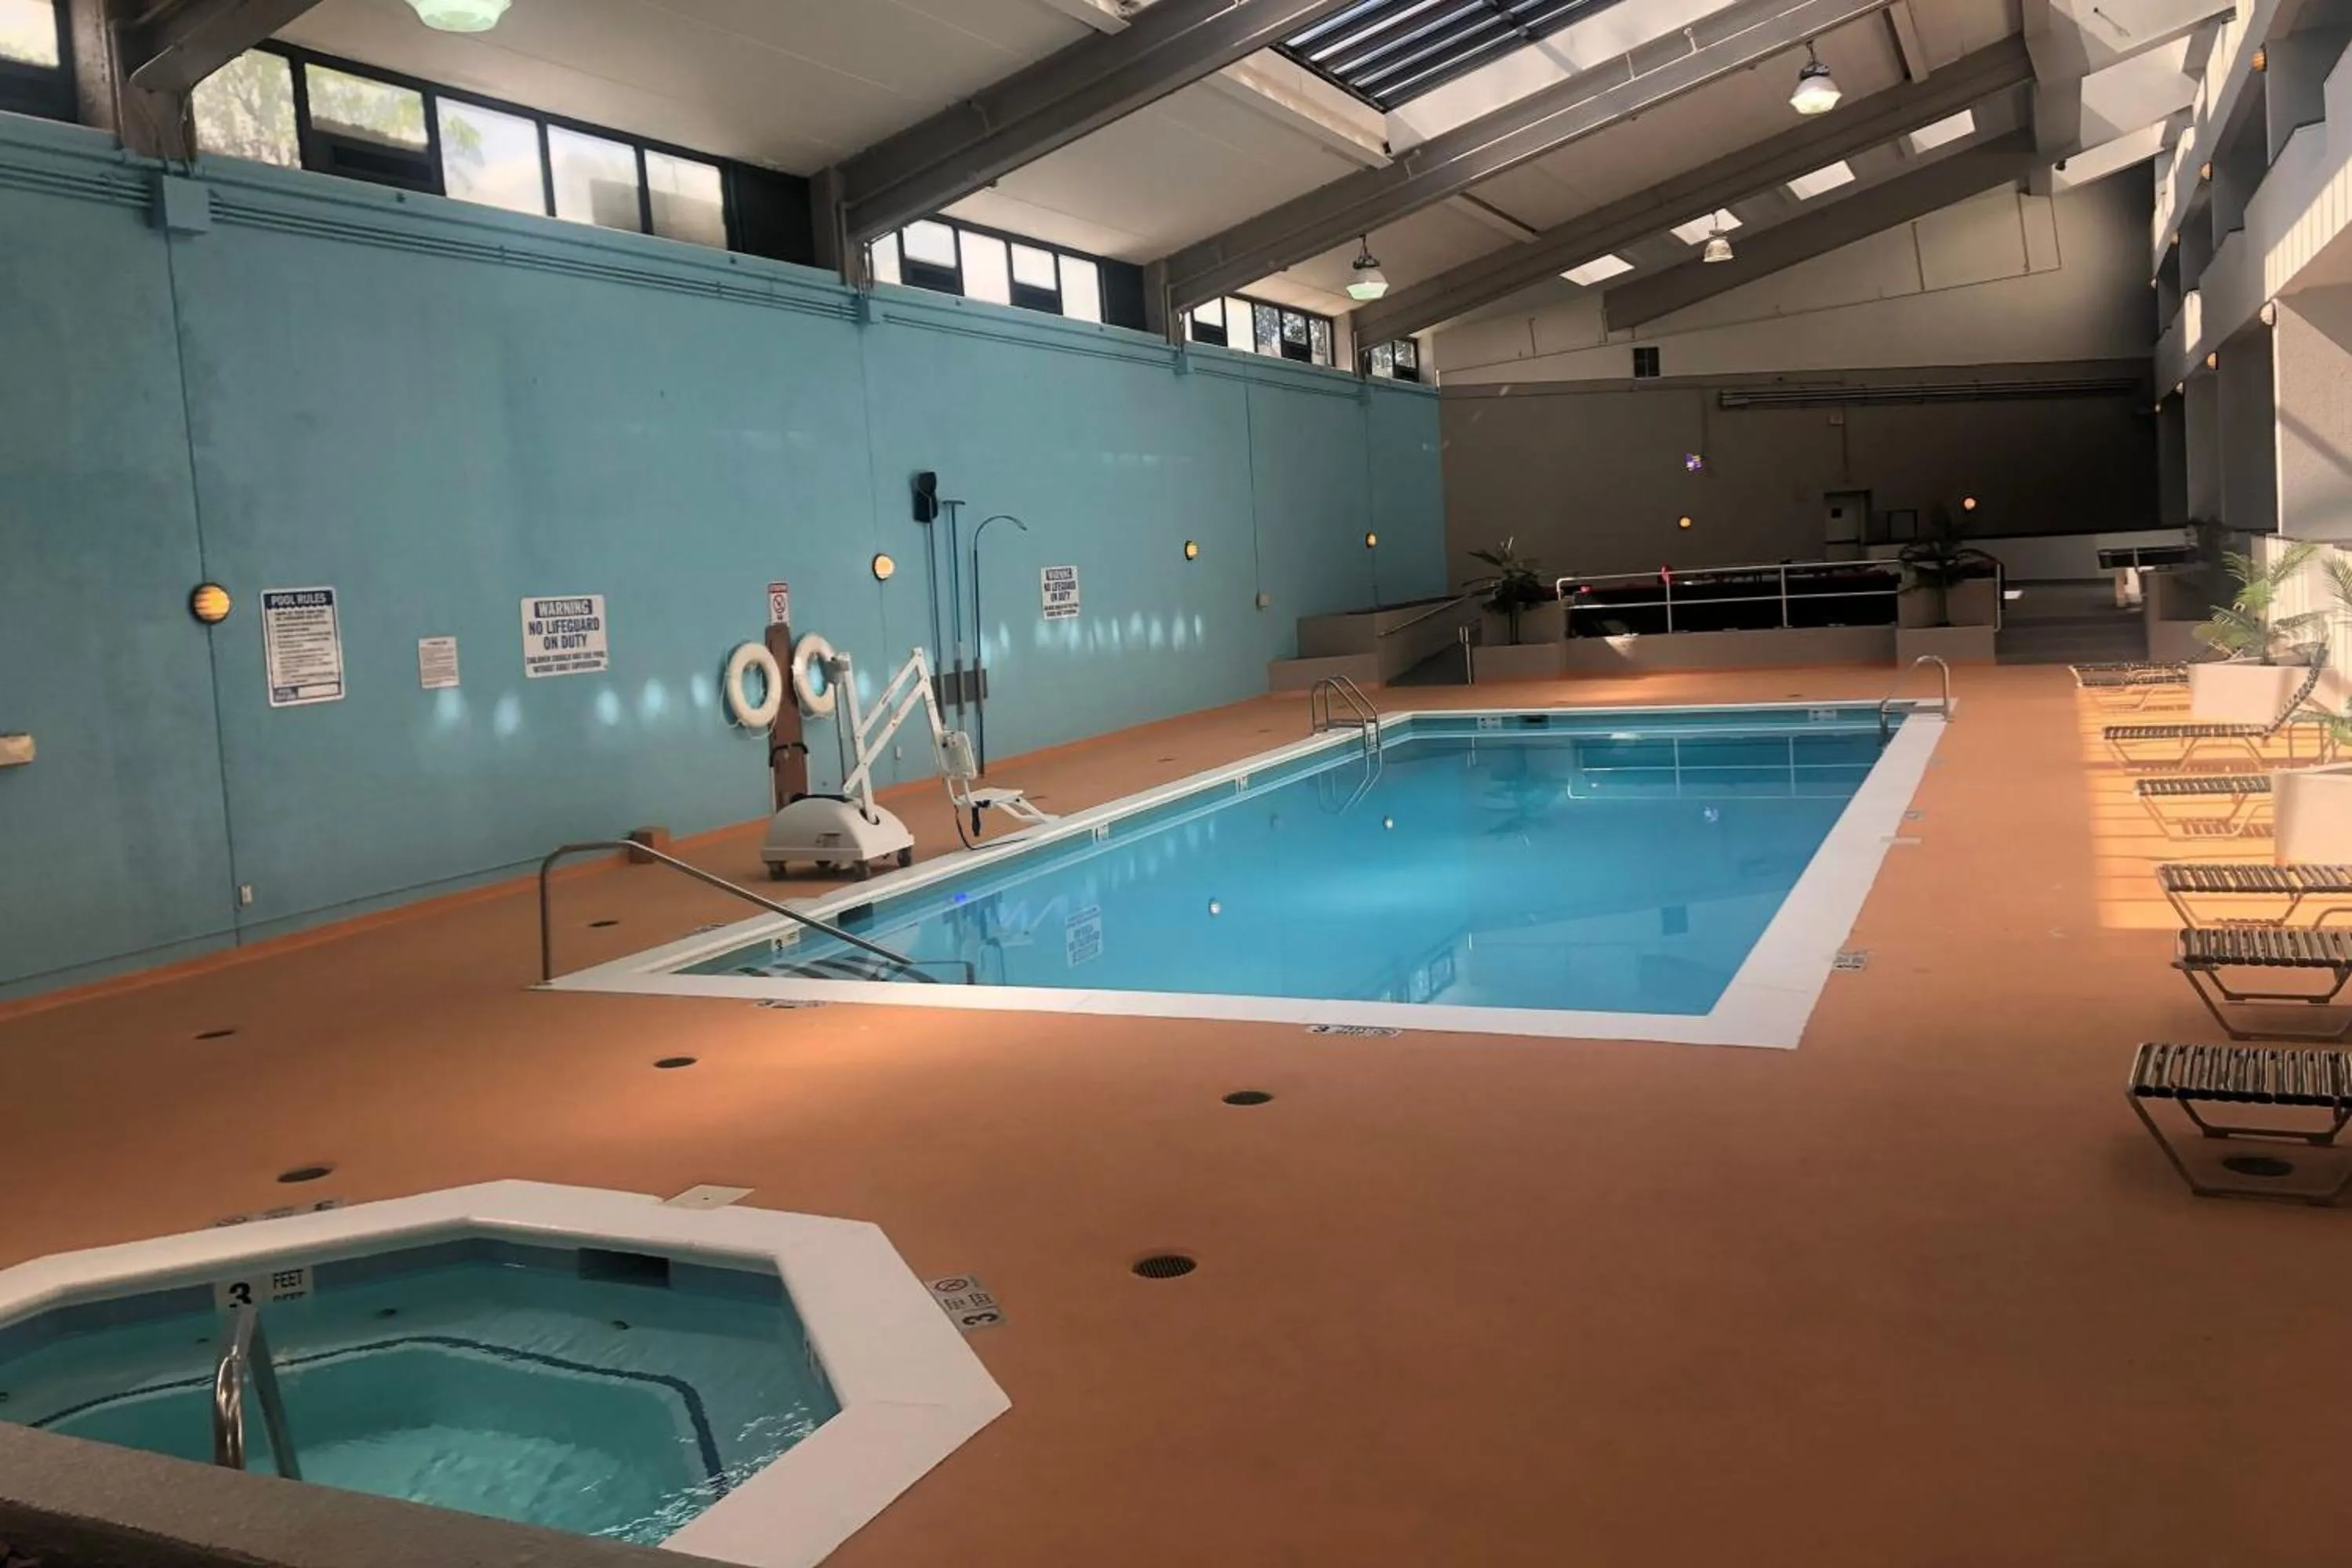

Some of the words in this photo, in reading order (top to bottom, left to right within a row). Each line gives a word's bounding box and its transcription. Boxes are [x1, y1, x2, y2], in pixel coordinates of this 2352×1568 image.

[270, 595, 296, 606] POOL
[297, 592, 327, 604] RULES
[539, 600, 590, 616] WARNING
[528, 621, 543, 635] NO
[546, 617, 600, 633] LIFEGUARD
[544, 636, 558, 651] ON
[561, 633, 587, 648] DUTY
[272, 1269, 304, 1290] FEET
